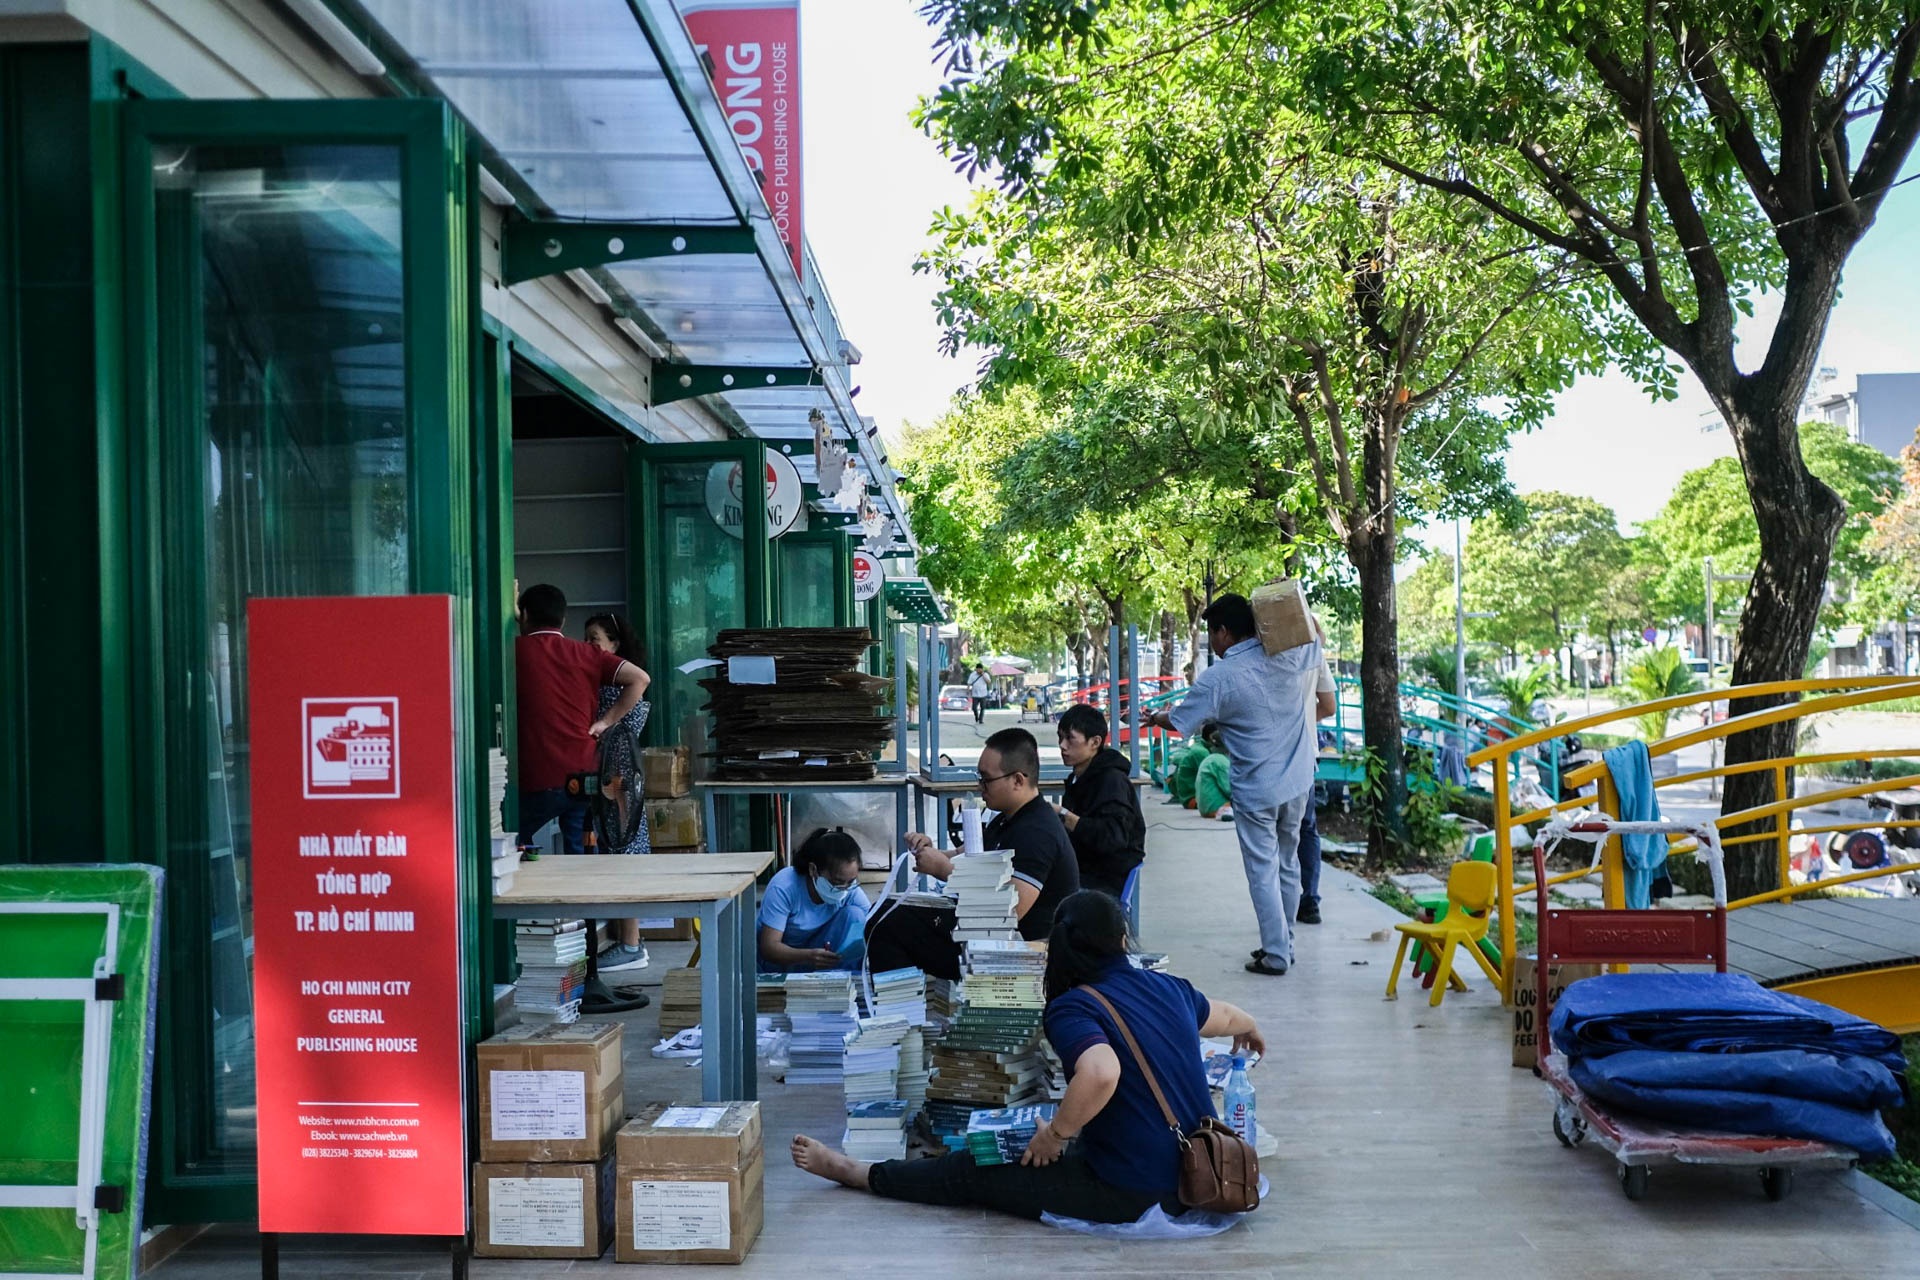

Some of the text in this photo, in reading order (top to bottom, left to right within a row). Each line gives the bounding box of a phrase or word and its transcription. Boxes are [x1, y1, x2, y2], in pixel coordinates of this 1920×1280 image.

[773, 42, 787, 94] HOUSE
[773, 98, 788, 187] PUBLISHING
[300, 829, 407, 857] NHÀ XUẤT BẢN
[316, 867, 391, 898] TỔNG HỢP
[295, 905, 414, 932] TP. HỒ CHÍ MINH
[301, 981, 411, 996] HO CHI MINH CITY
[328, 1009, 384, 1024] GENERAL
[297, 1037, 417, 1053] PUBLISHING HOUSE
[298, 1115, 419, 1127] Website: www.nxbhcm.com.vn
[1234, 1104, 1245, 1129] Life
[339, 1130, 408, 1141] www.sachweb.vn
